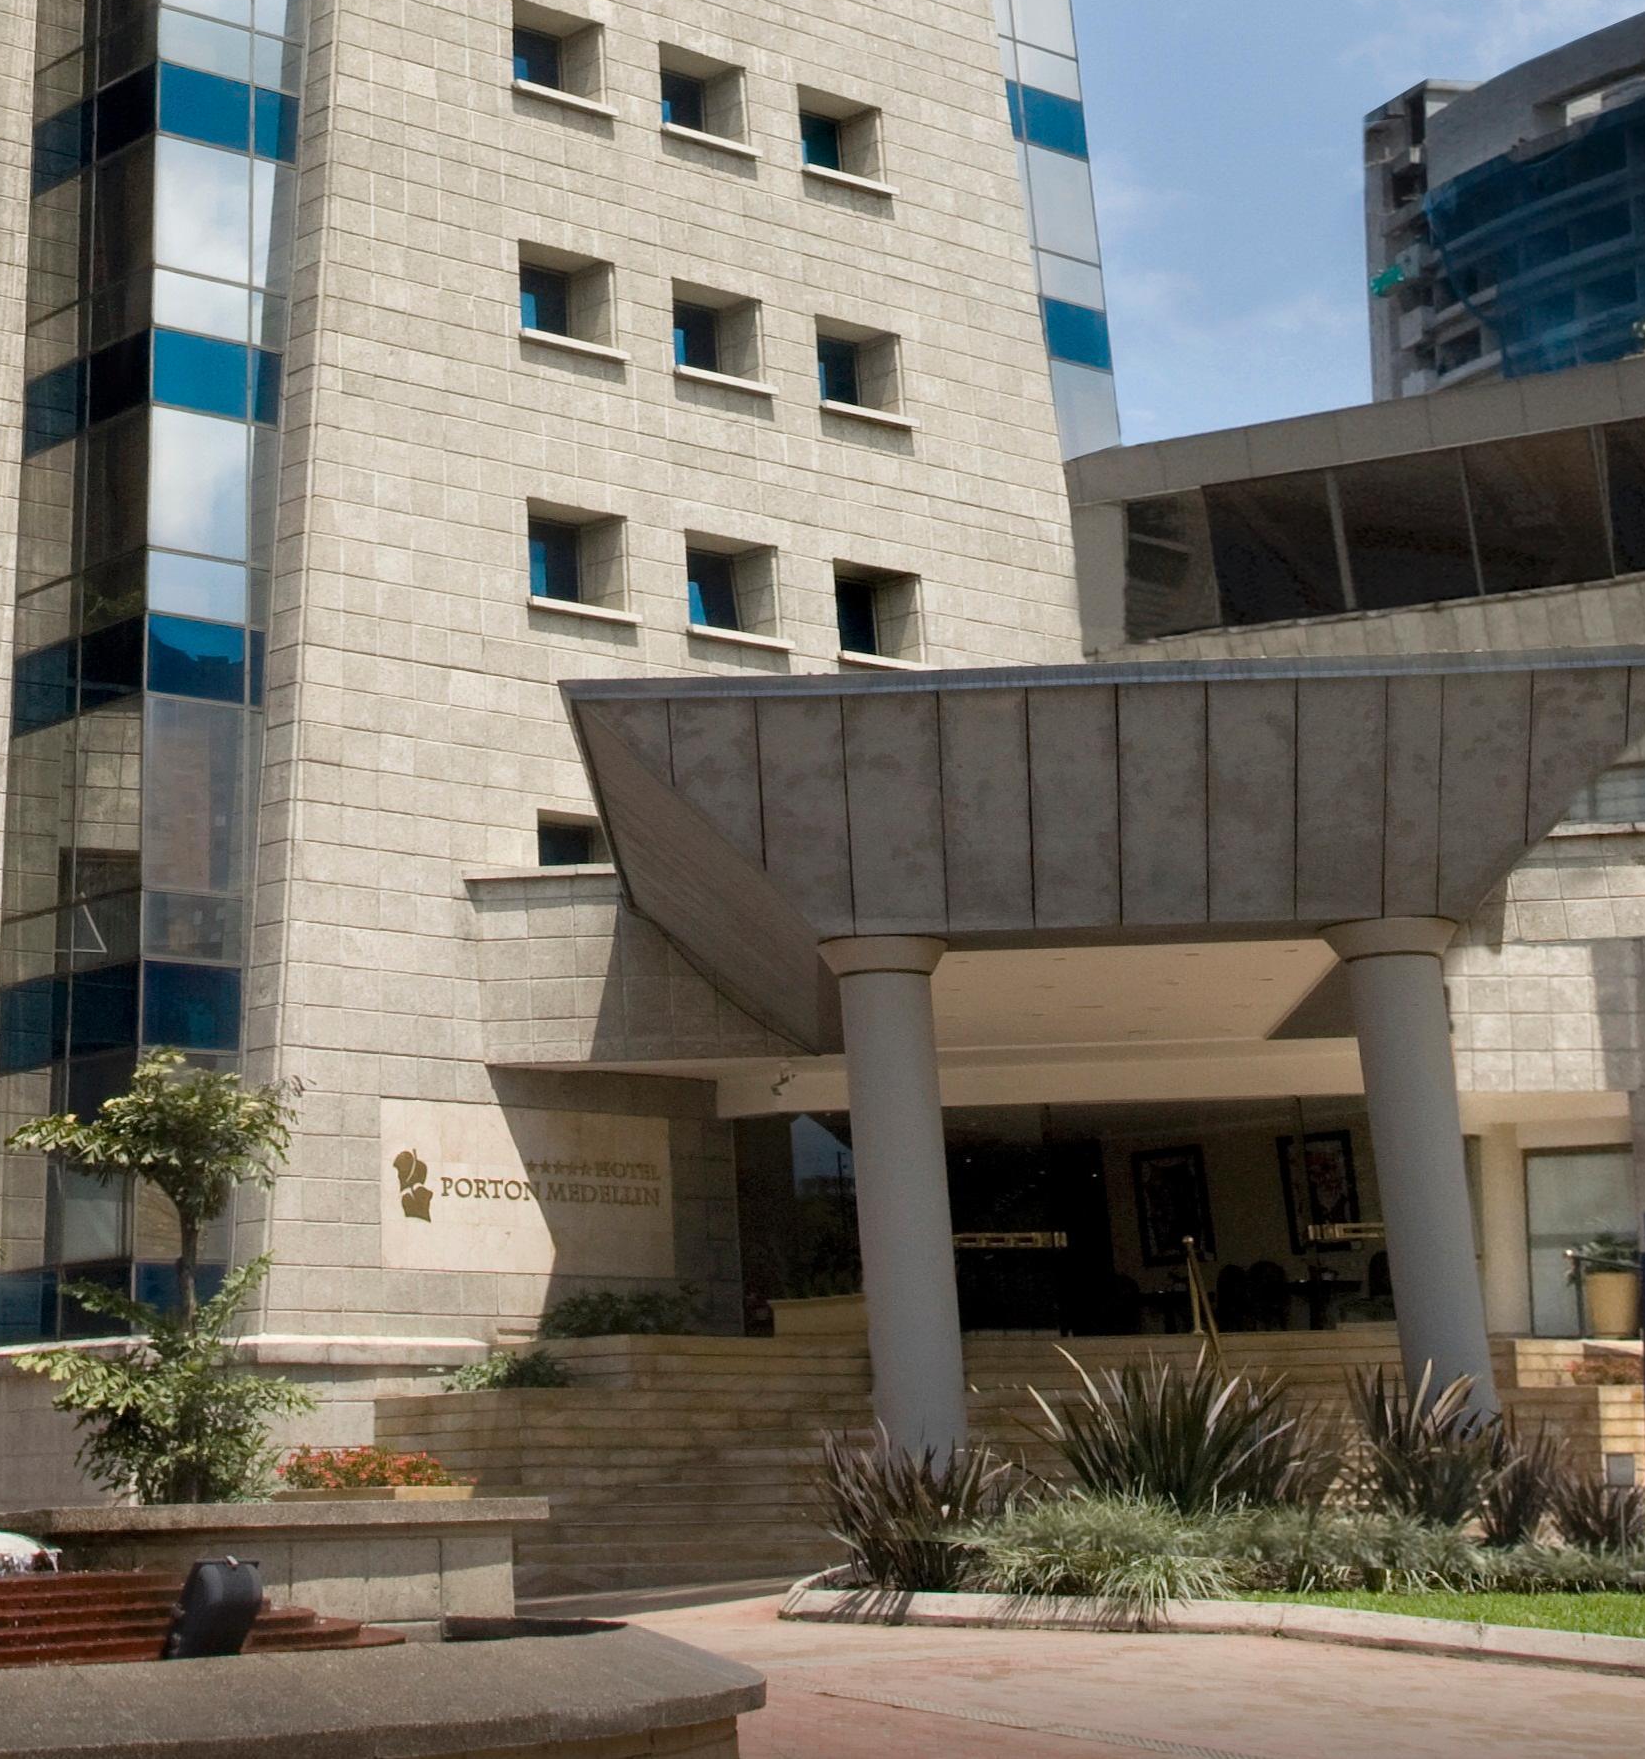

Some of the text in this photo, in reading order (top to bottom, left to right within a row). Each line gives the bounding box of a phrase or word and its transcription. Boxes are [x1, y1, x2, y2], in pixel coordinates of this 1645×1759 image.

[595, 1161, 660, 1180] HOTEL
[440, 1176, 660, 1207] PORTON MEDELLIN
